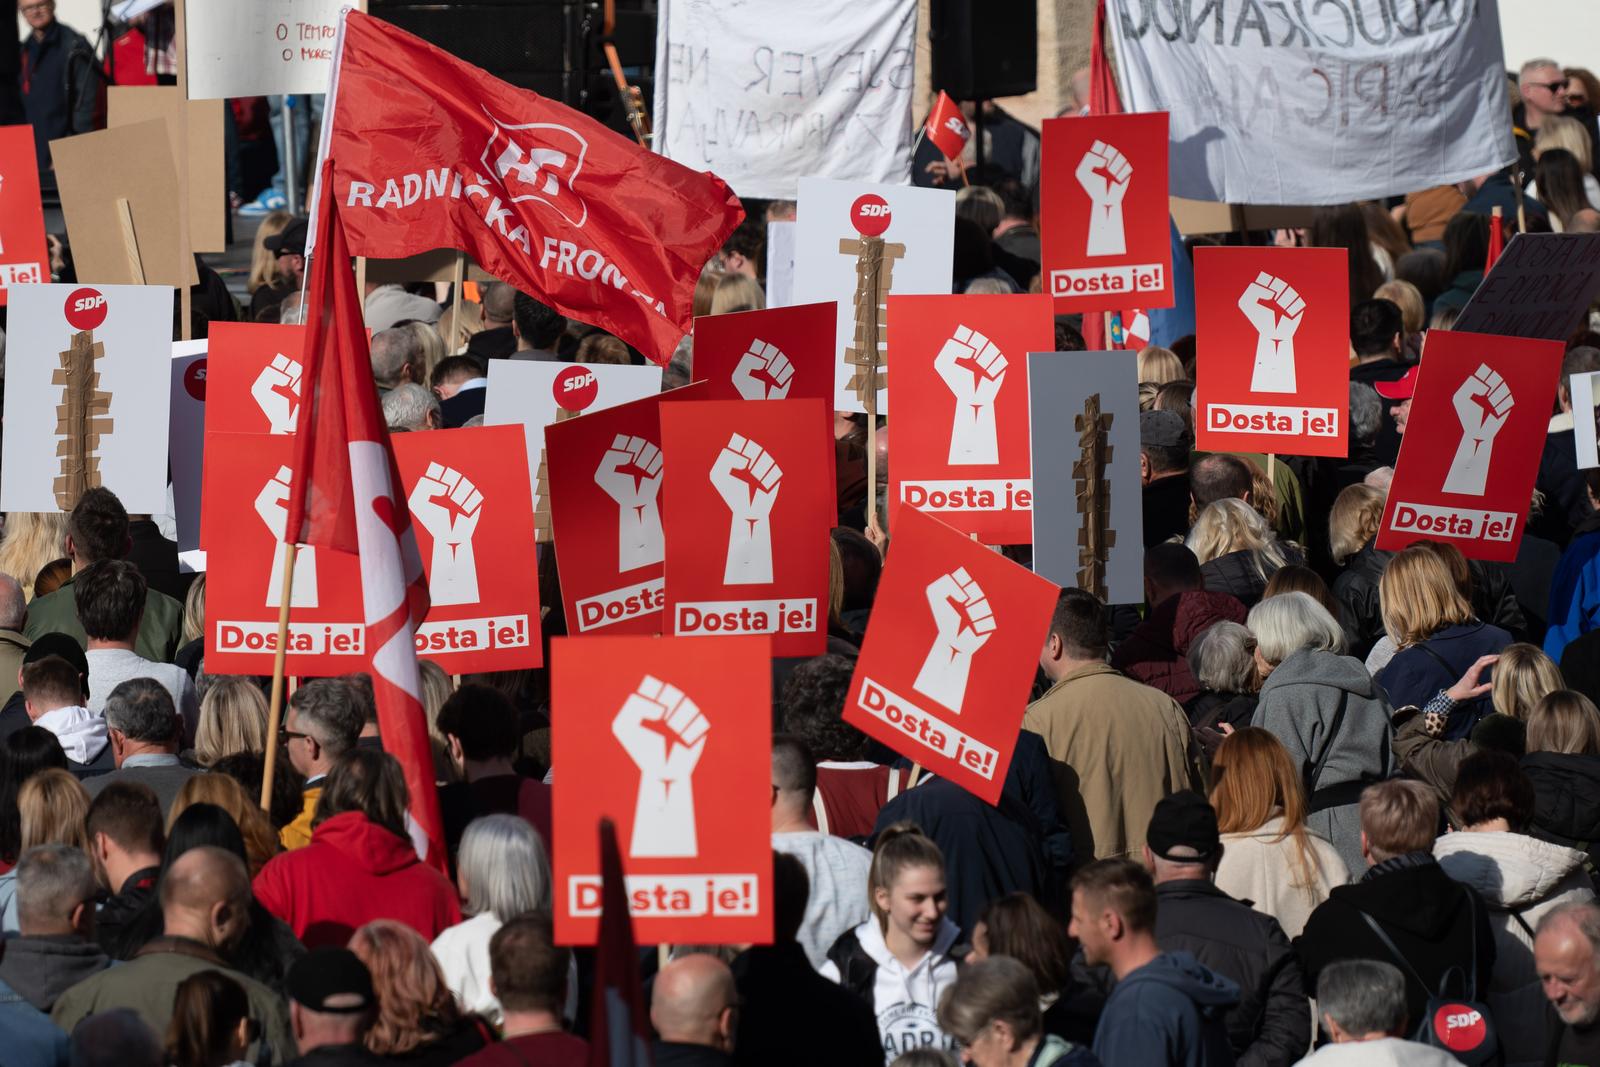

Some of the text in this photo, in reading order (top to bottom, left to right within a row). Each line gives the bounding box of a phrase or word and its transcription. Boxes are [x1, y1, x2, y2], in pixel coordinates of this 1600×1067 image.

[276, 23, 288, 41] O
[282, 48, 293, 61] O
[859, 204, 891, 217] SDP
[1054, 268, 1160, 293] Dosta je!
[74, 295, 106, 313] SDP
[563, 372, 595, 393] SDP
[1211, 408, 1335, 436] Dosta je!
[904, 485, 995, 509] Dosta
[1394, 506, 1513, 540] Dosta je!
[679, 602, 813, 633] Dosta je!
[323, 626, 361, 655] je!
[414, 619, 525, 650] osta je!
[863, 684, 993, 774] Dosta je!
[576, 880, 751, 914] Dsta je!
[1446, 1010, 1482, 1029] SDP
